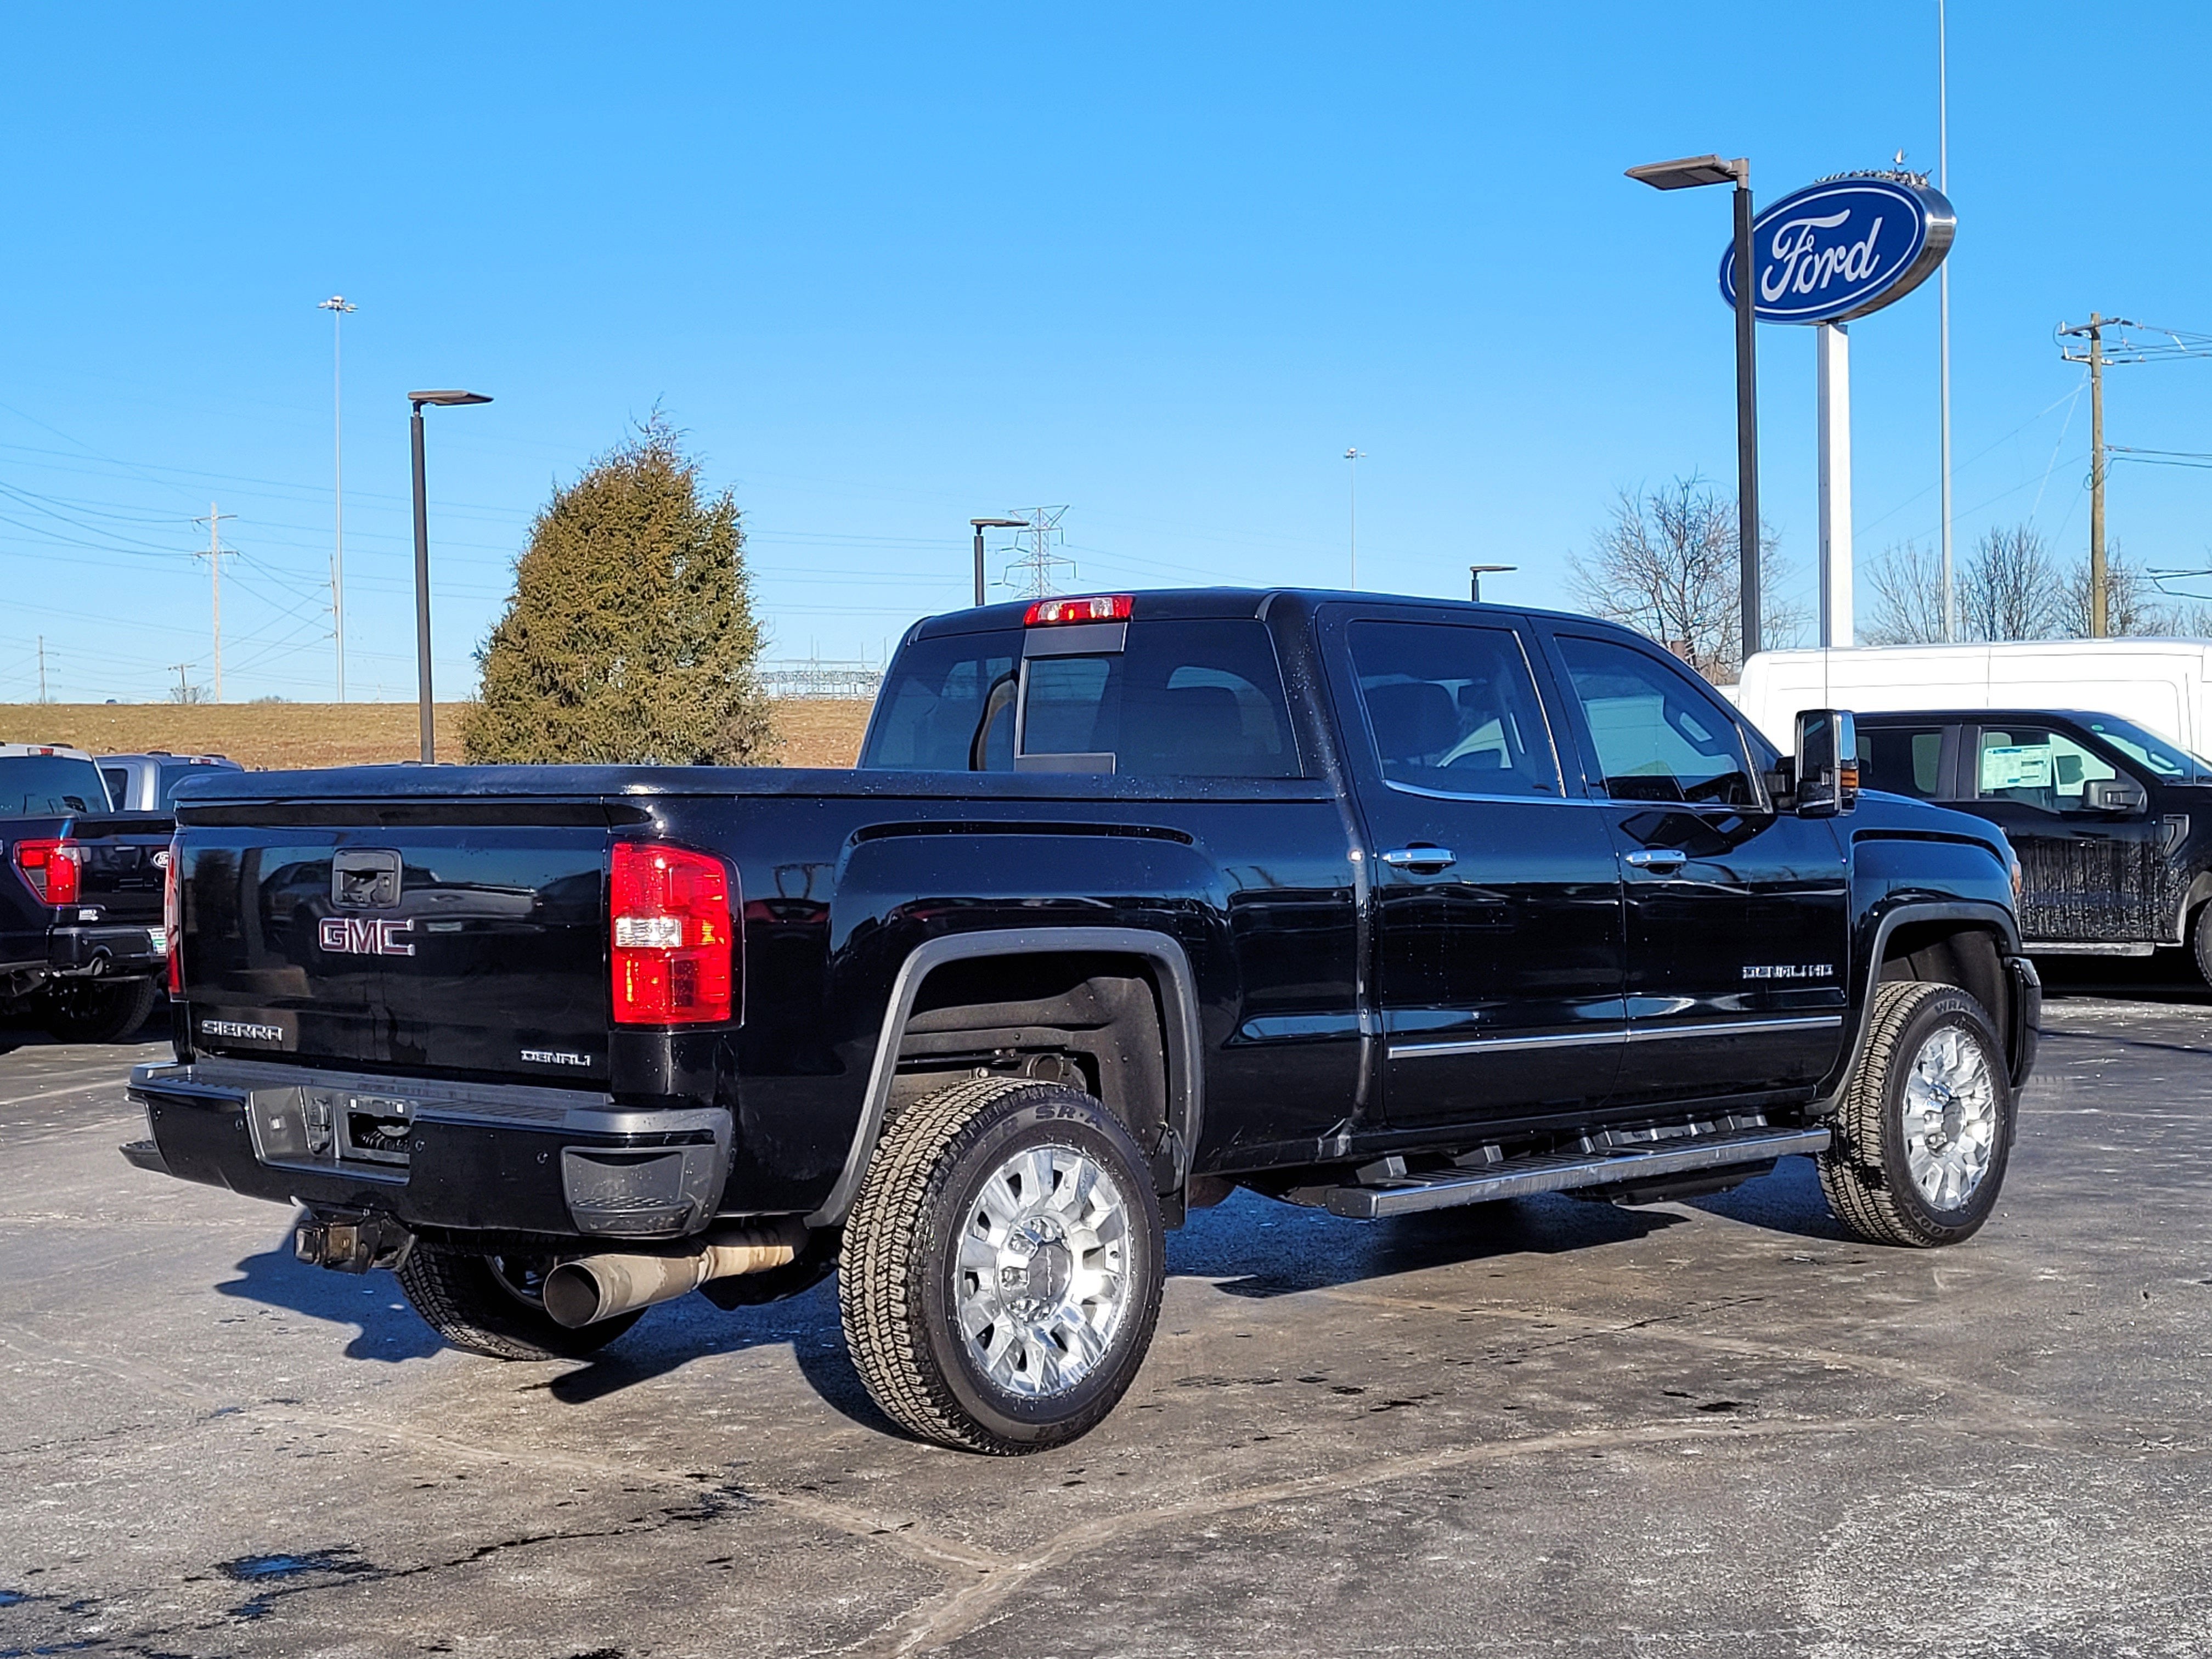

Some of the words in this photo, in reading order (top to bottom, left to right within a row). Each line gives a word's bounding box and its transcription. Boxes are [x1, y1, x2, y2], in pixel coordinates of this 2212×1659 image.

[1760, 209, 1883, 302] Ford
[319, 917, 415, 956] GMC
[1742, 965, 1807, 979] DENALI
[201, 1019, 283, 1041] SIERRA
[520, 1049, 591, 1067] DENALI
